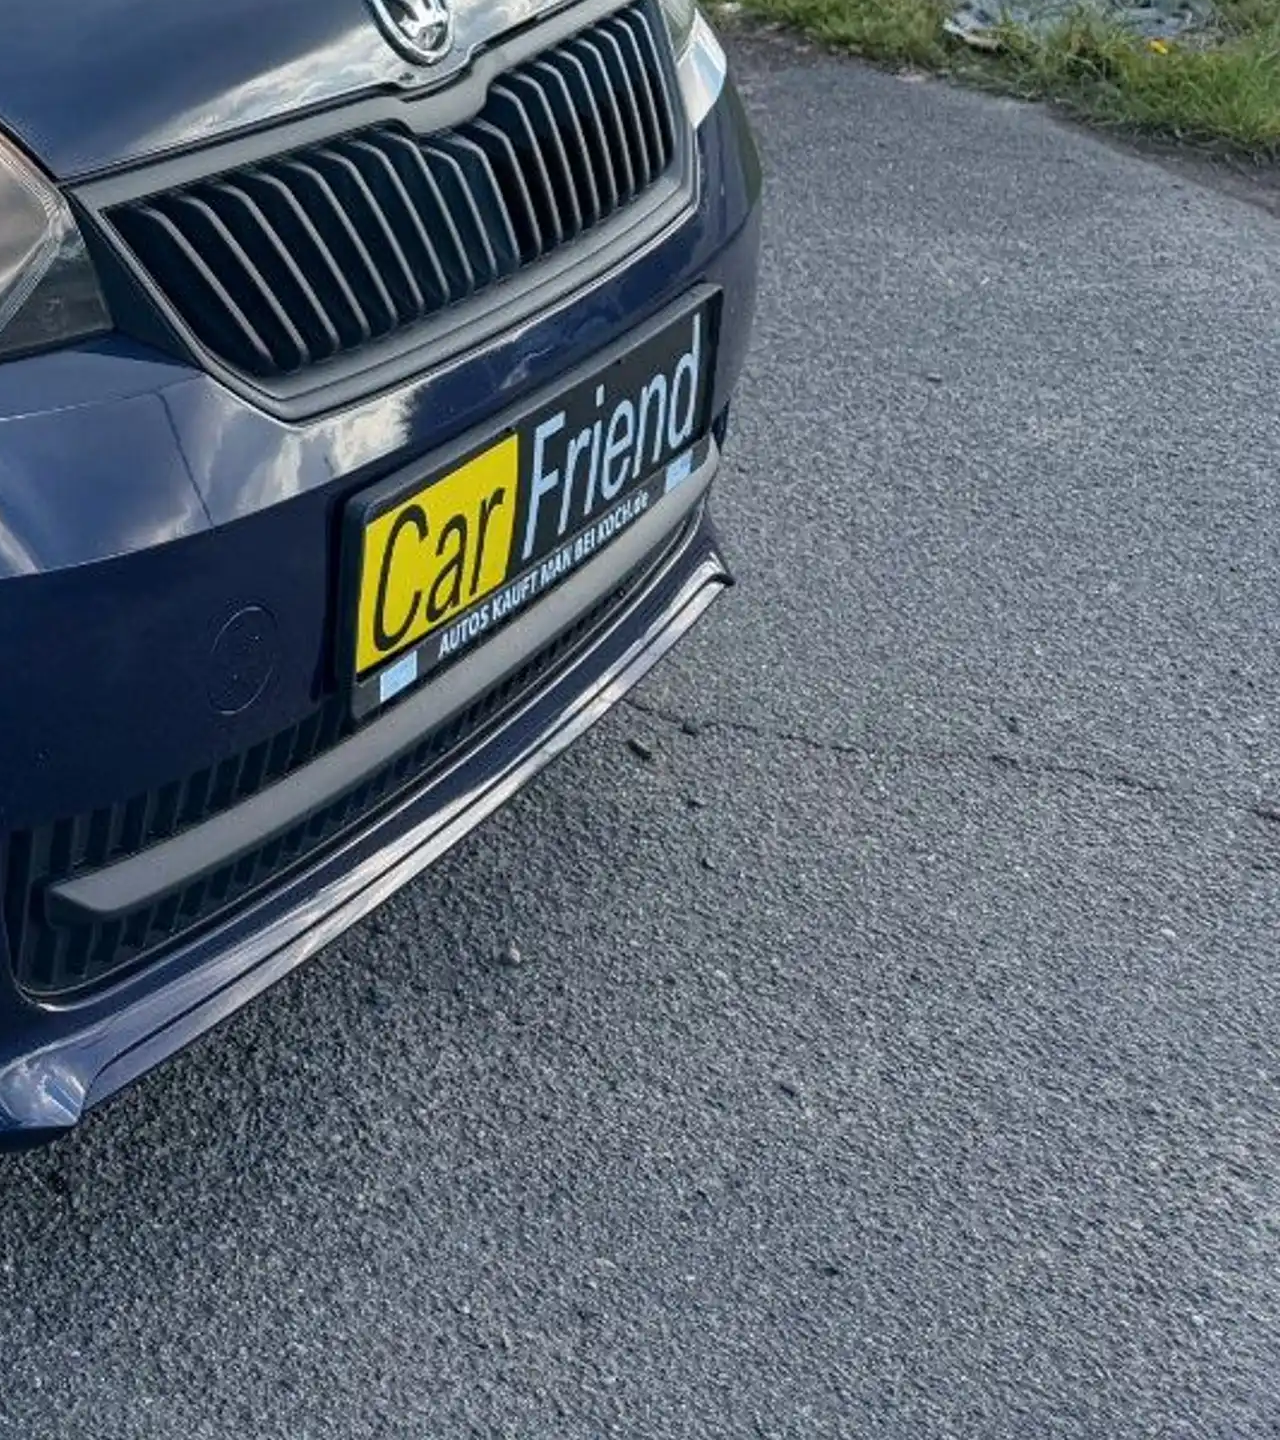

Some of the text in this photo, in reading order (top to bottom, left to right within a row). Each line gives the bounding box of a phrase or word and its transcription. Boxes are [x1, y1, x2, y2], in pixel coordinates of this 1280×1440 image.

[372, 312, 701, 651] Car Friend
[439, 606, 490, 660] AUTOS
[493, 569, 540, 621] KAUFT
[540, 545, 573, 587] MAN
[574, 526, 596, 561] BEI
